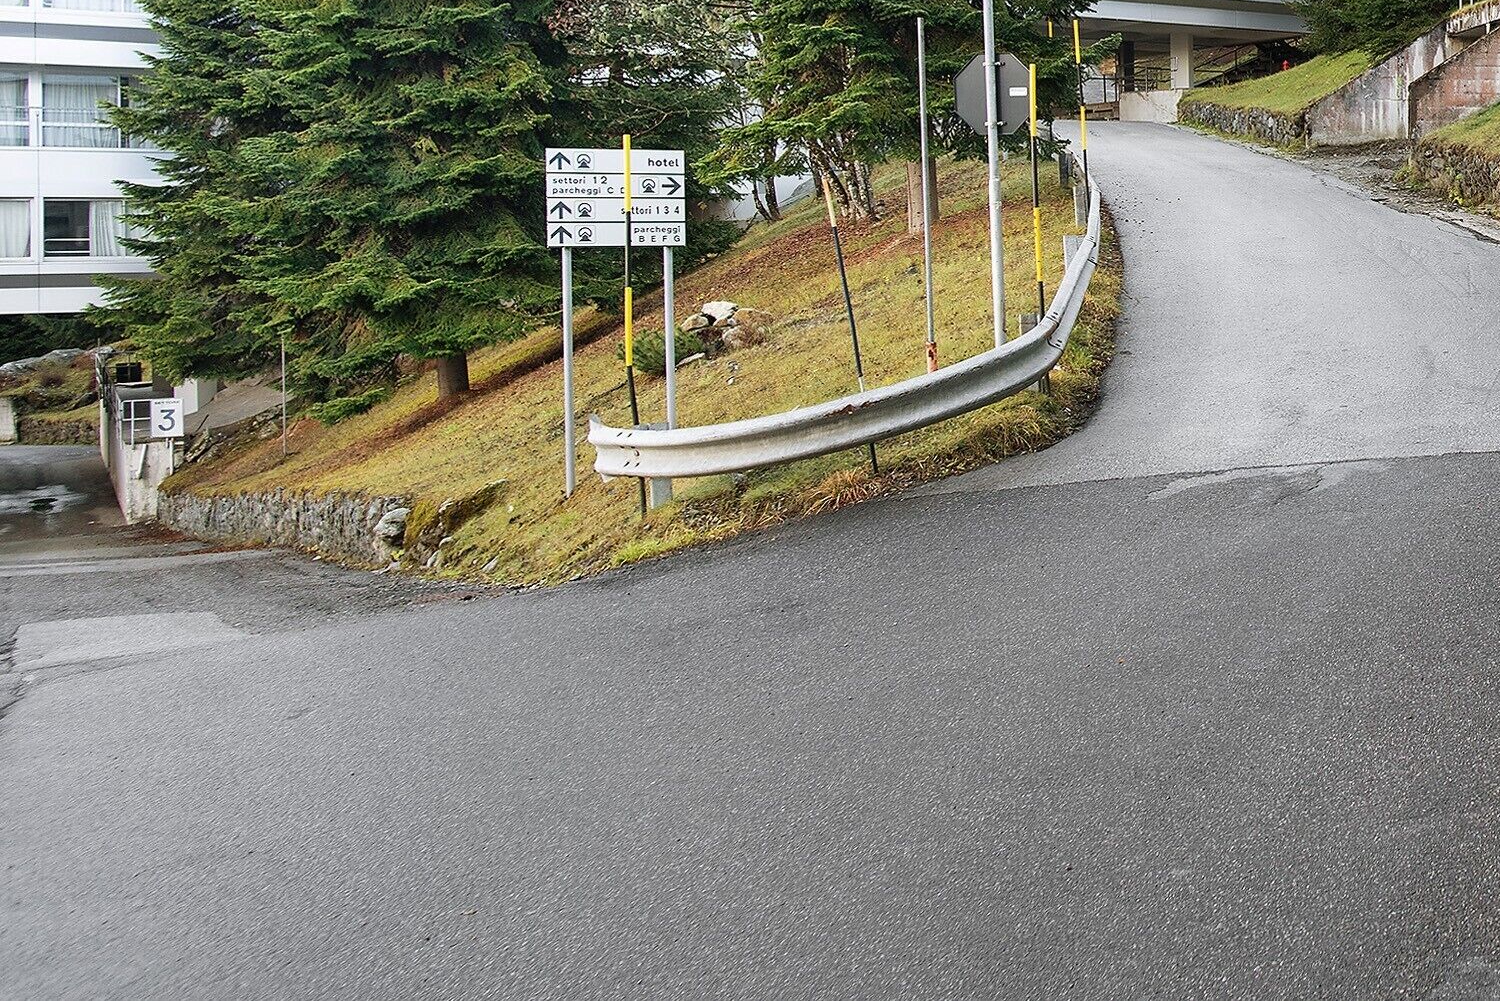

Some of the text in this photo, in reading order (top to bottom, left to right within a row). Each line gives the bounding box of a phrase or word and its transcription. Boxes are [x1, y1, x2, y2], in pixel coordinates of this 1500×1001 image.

[647, 157, 680, 167] hotel
[552, 176, 608, 185] settori 1 2
[552, 186, 602, 195] parcheggi
[606, 186, 614, 194] C
[620, 205, 680, 215] sttori 1 3 4
[633, 225, 681, 235] parcheggi
[638, 235, 646, 243] B
[651, 235, 657, 243] E
[662, 235, 668, 243] F
[673, 234, 681, 243] G
[158, 409, 175, 431] 3
